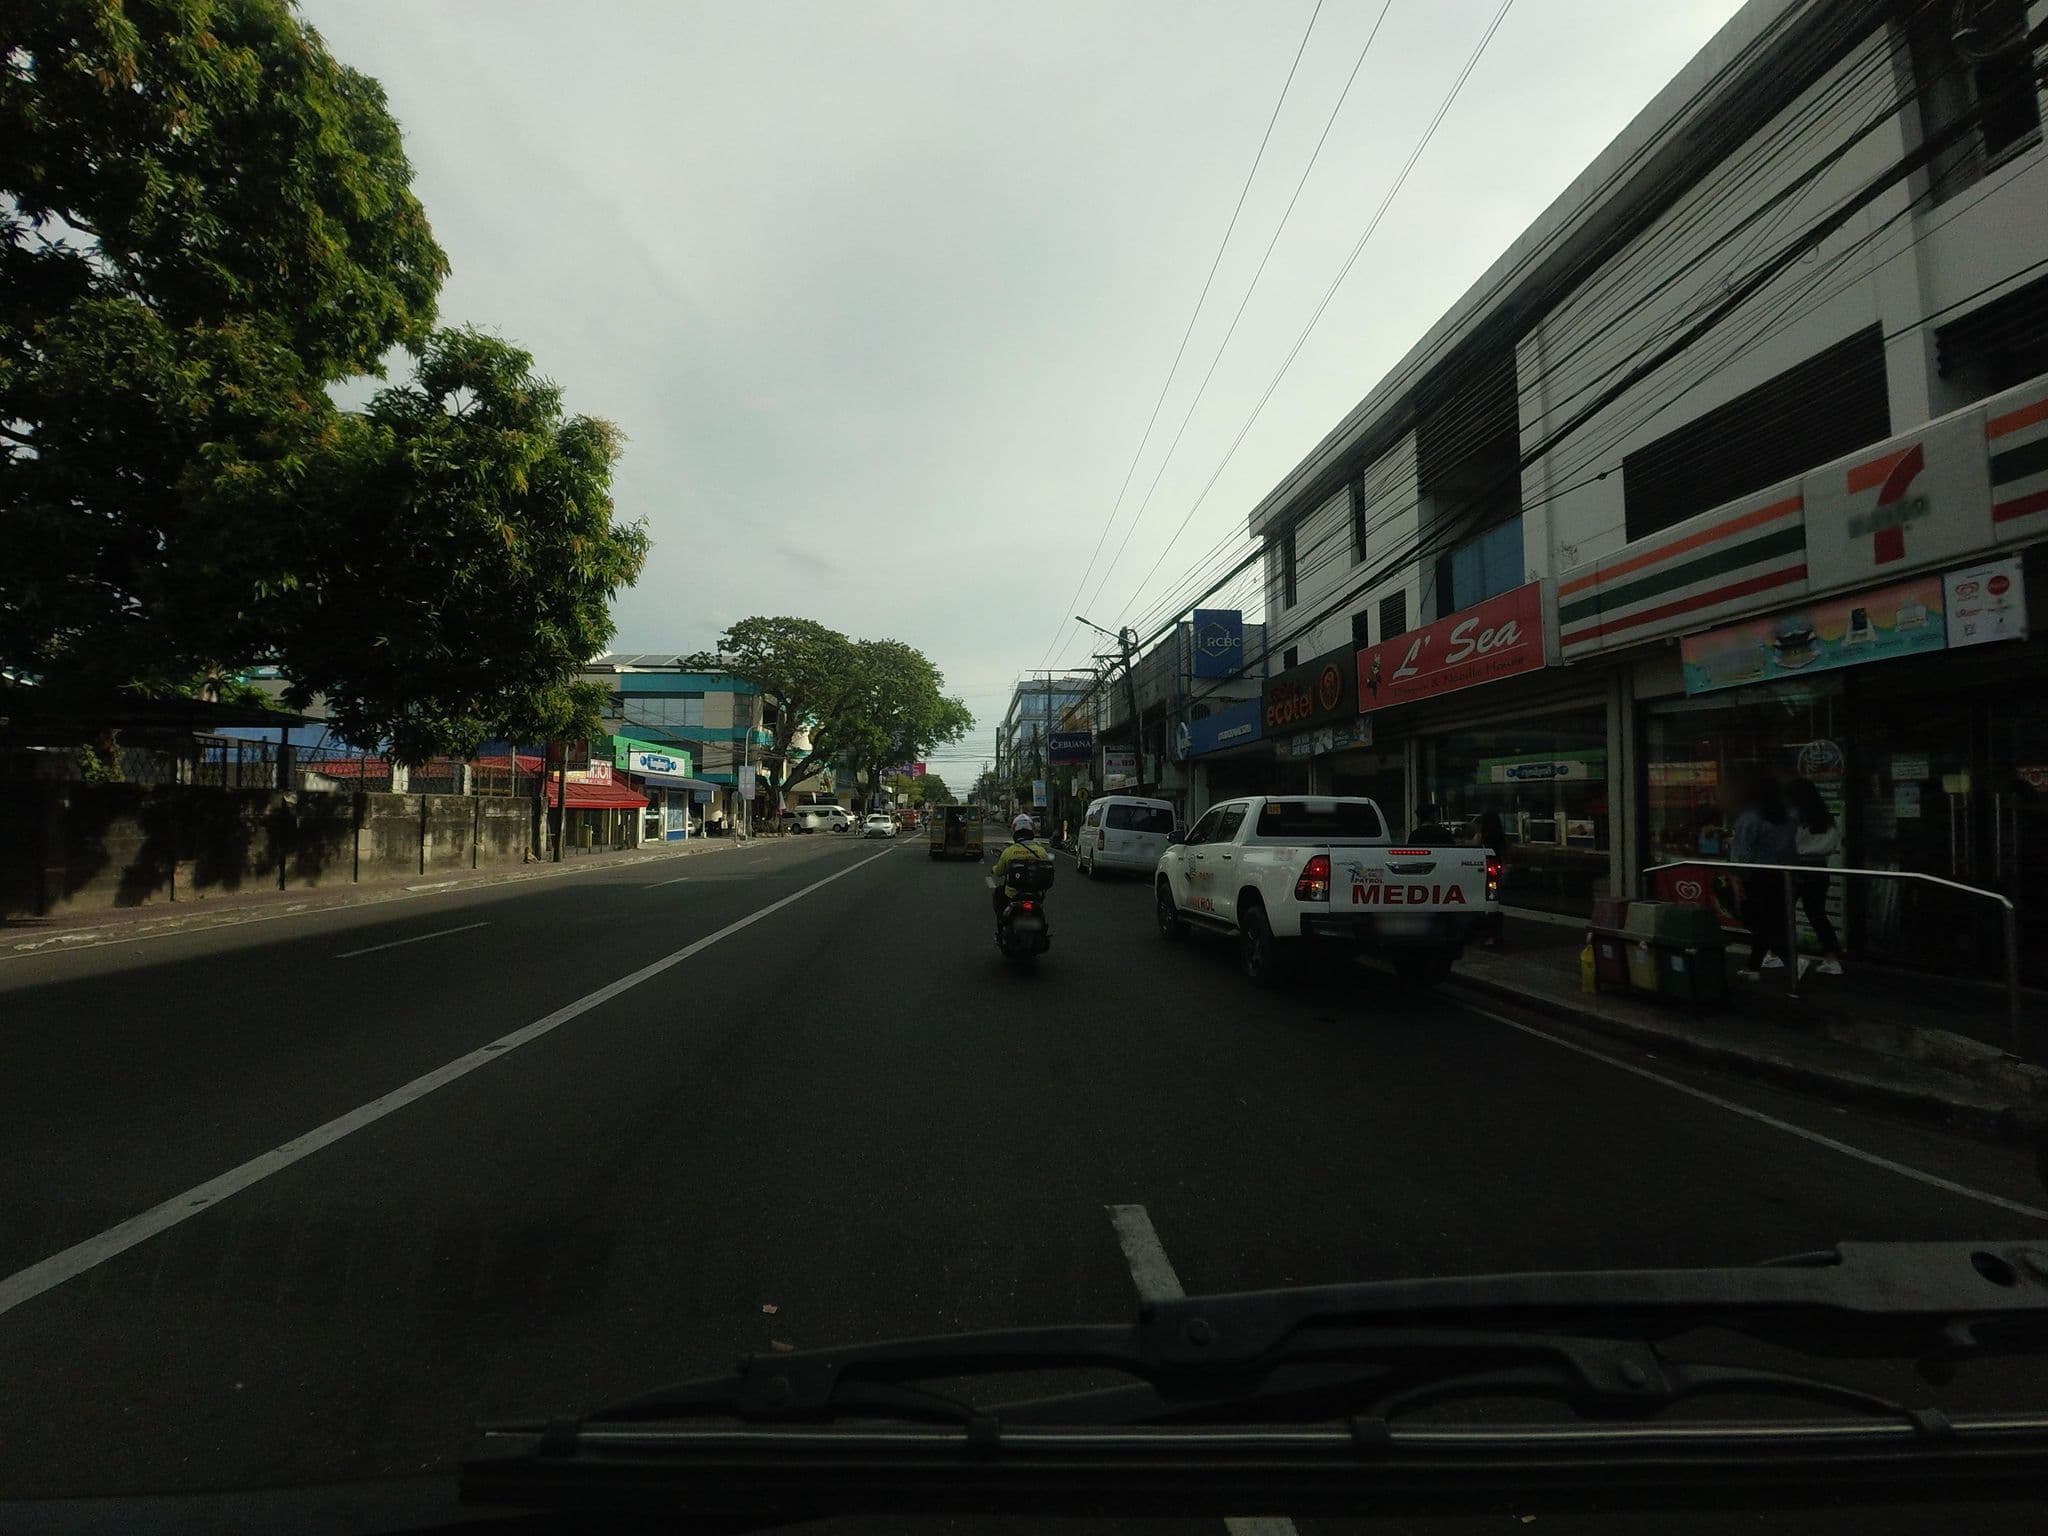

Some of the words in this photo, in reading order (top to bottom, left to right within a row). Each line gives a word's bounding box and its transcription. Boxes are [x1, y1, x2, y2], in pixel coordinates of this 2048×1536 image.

[1207, 637, 1241, 648] RCBC
[1392, 635, 1431, 680] L'
[1446, 616, 1523, 664] Sea
[1266, 692, 1313, 727] ecotel
[1049, 740, 1092, 751] CEBUANA
[1352, 884, 1467, 905] MEDIA
